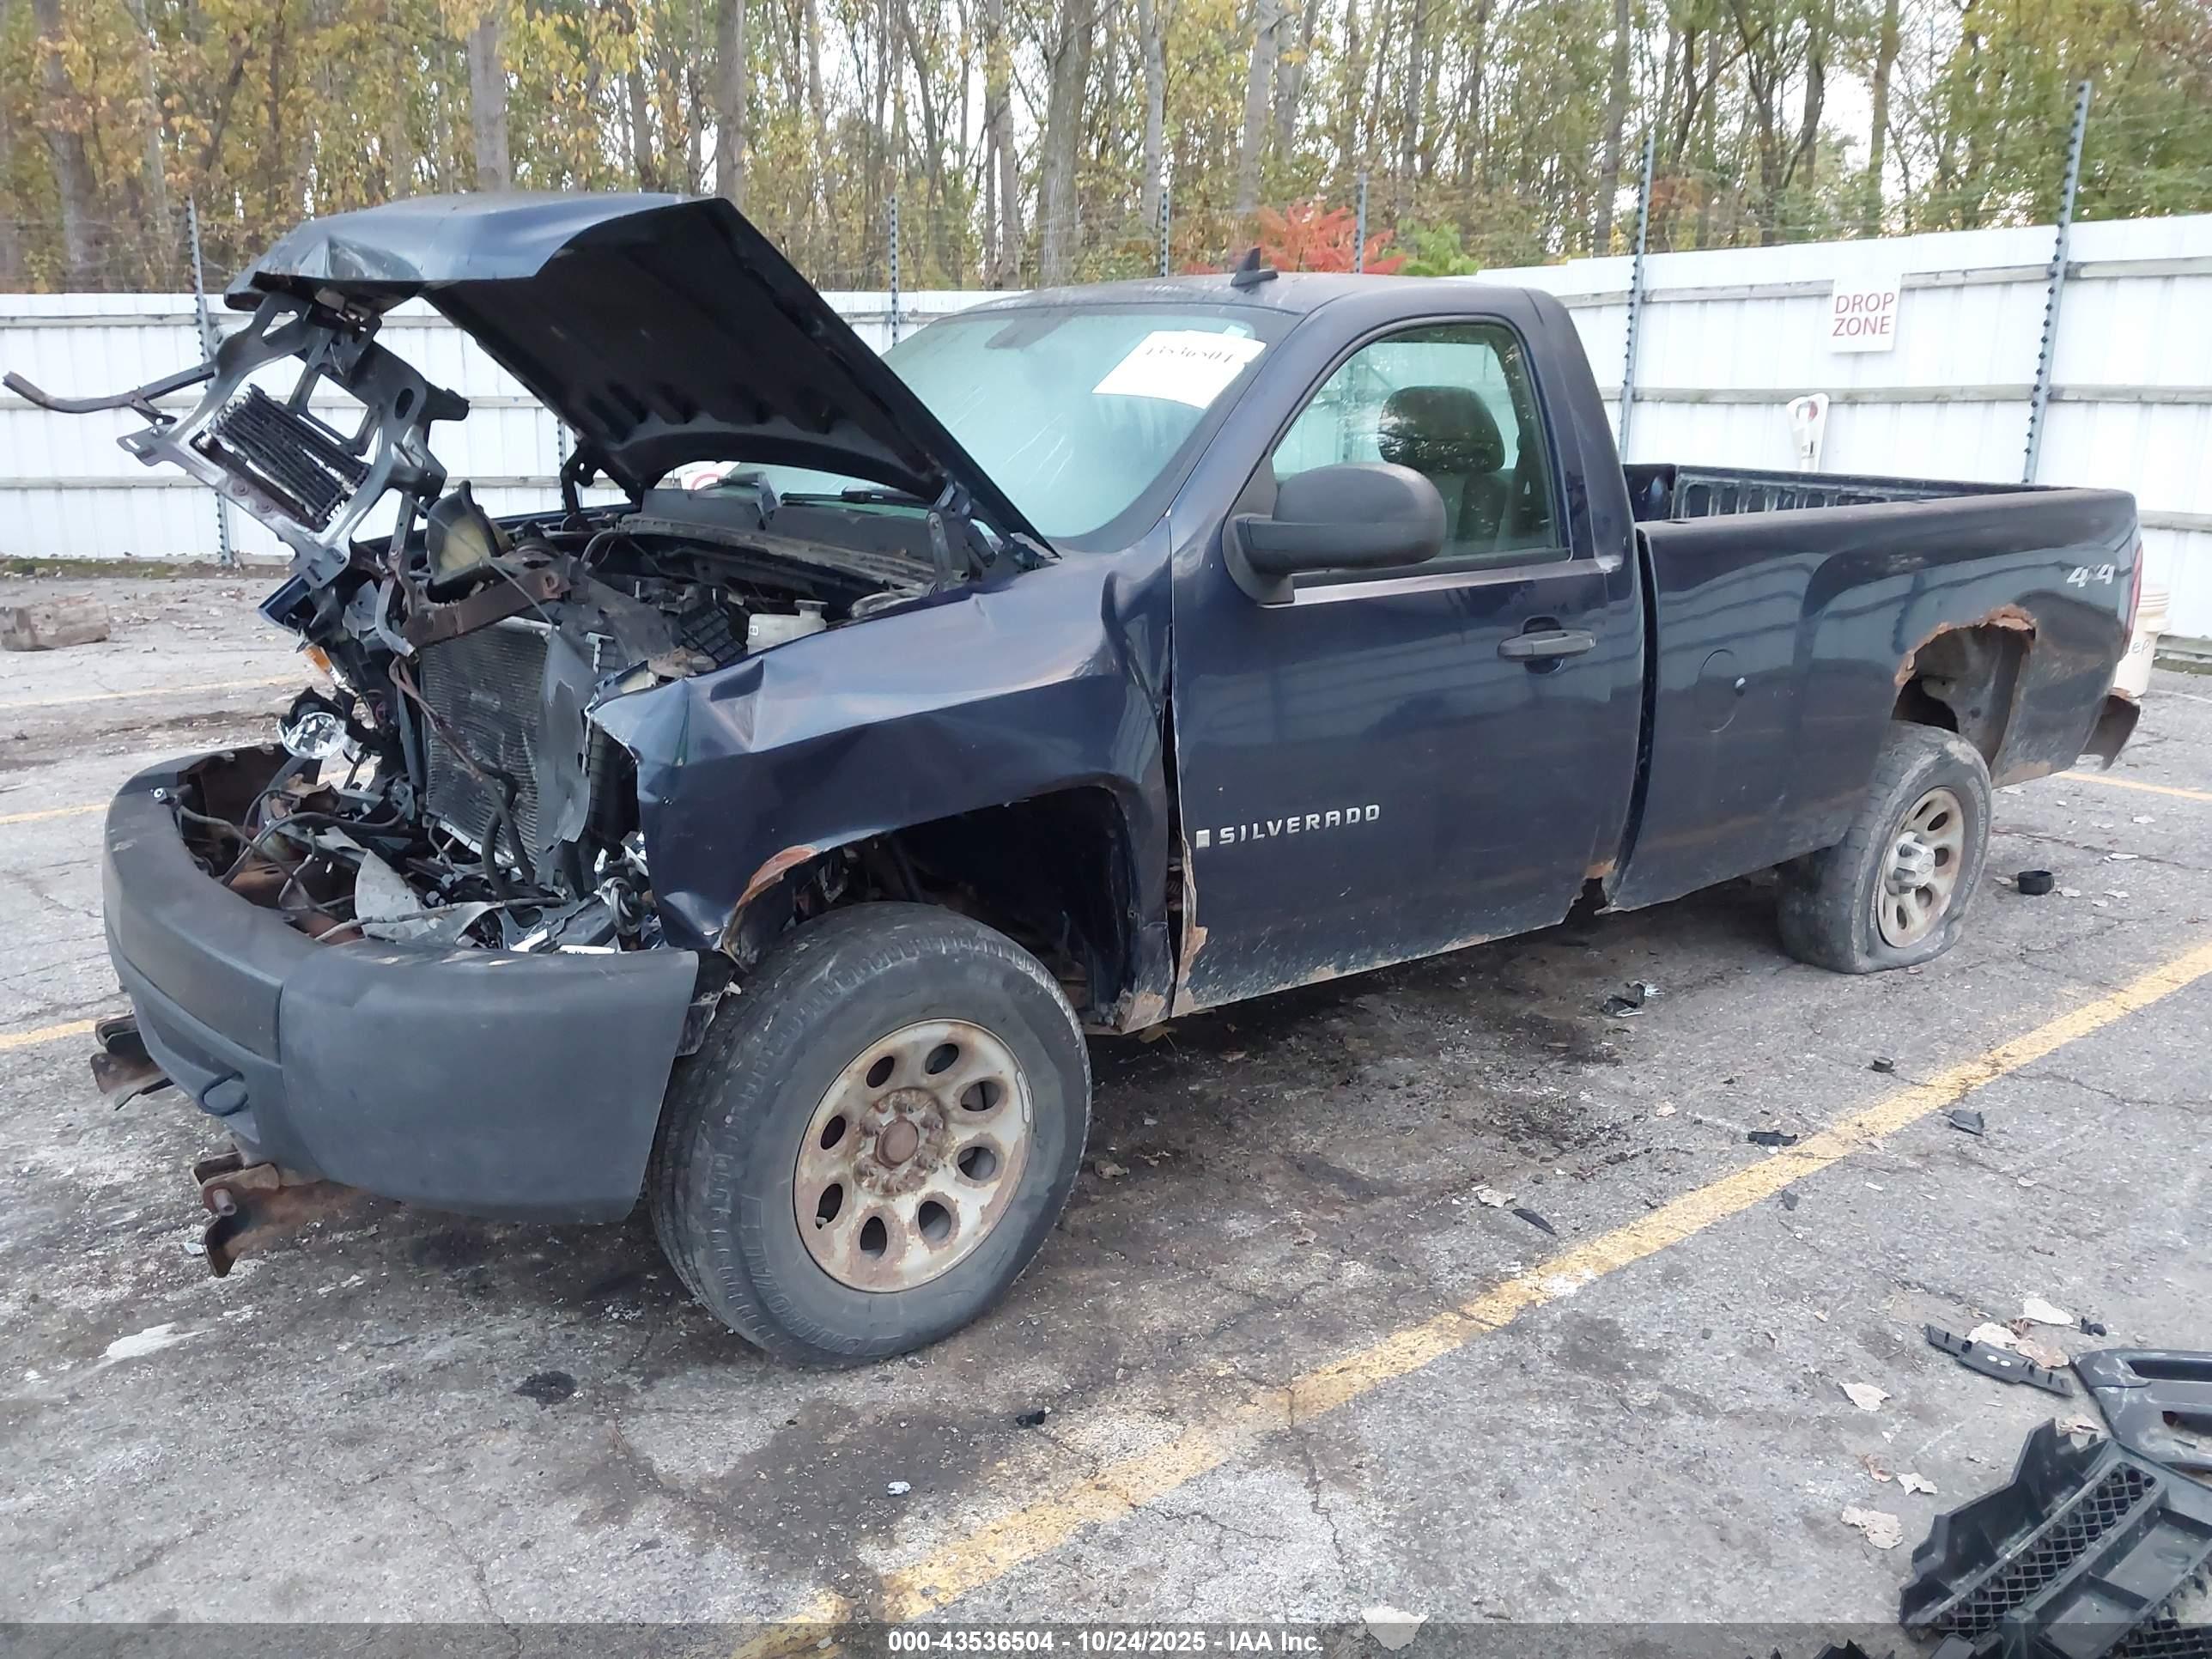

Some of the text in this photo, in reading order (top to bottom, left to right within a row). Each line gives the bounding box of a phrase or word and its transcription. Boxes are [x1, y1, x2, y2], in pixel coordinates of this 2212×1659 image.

[1835, 292, 1895, 314] DROP
[1832, 316, 1892, 337] ZONE
[1218, 804, 1381, 845] SILVERADO
